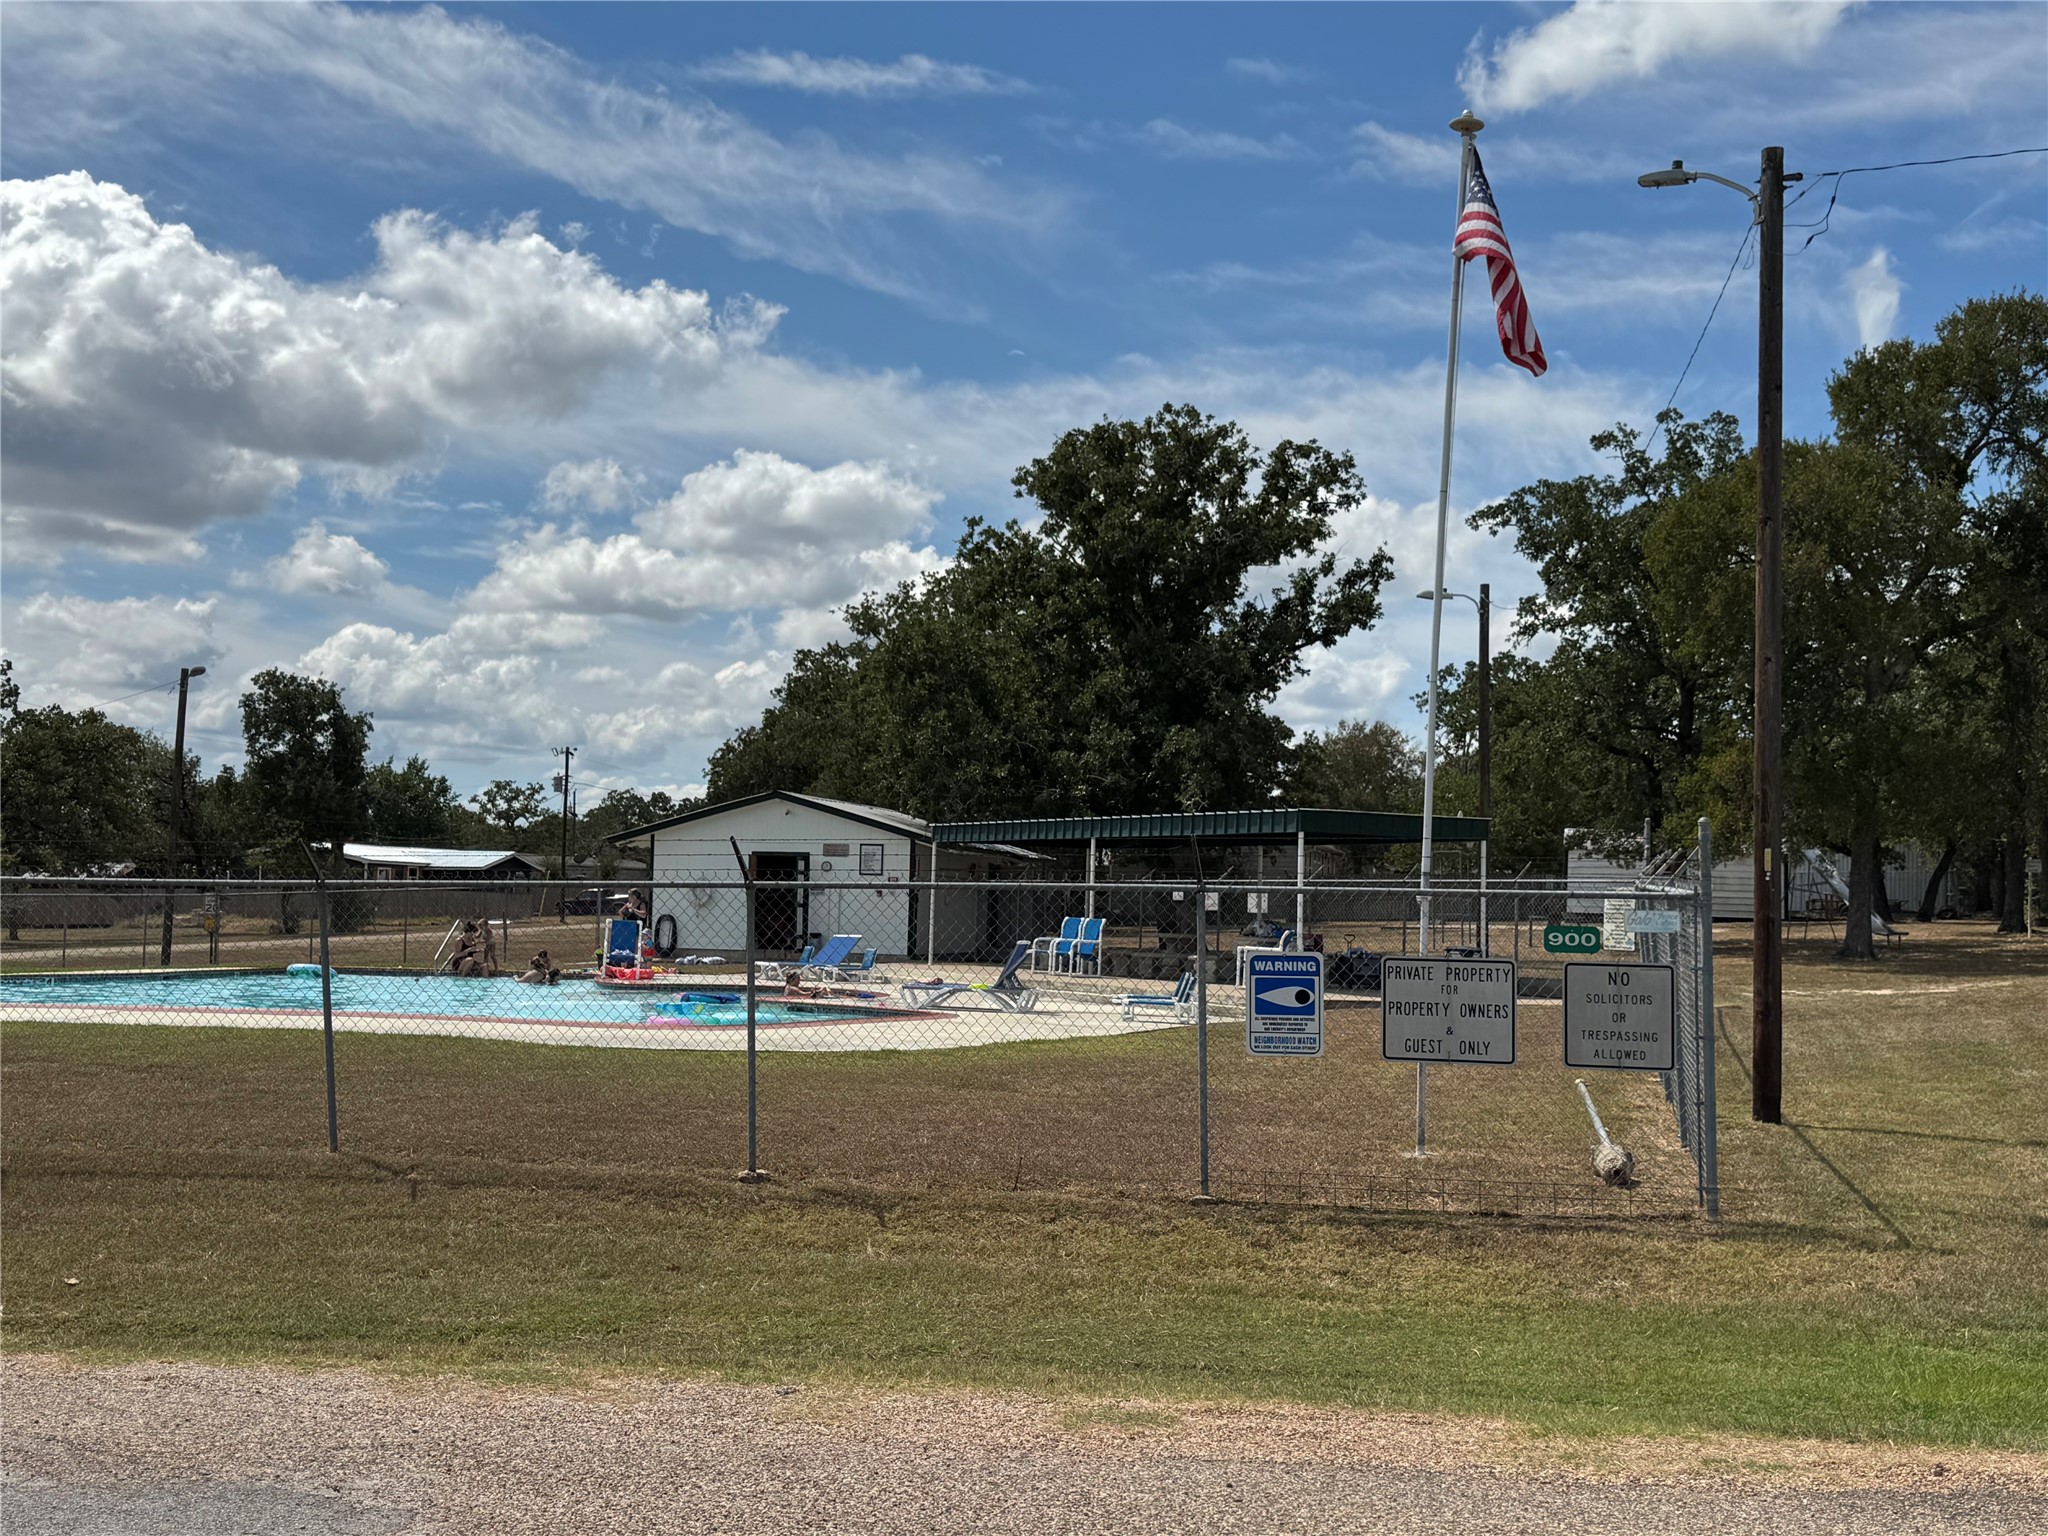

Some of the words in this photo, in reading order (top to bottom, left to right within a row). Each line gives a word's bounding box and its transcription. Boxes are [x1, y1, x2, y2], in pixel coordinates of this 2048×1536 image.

[1548, 932, 1596, 947] 900
[1254, 961, 1317, 972] WARNING
[1387, 965, 1434, 981] PRIVATE
[1446, 967, 1510, 983] PROPERTY
[1608, 971, 1630, 987] NO
[1441, 984, 1458, 995] FOR
[1586, 993, 1653, 1005] SOLICITORS
[1388, 1001, 1450, 1017] PROPERTY
[1460, 1003, 1509, 1019] OWNERS
[1612, 1012, 1626, 1023] OR
[1446, 1026, 1453, 1035] &
[1581, 1030, 1659, 1043] TRESPASSING
[1254, 1036, 1296, 1045] NEIGHBORHOOD
[1297, 1037, 1317, 1045] WATCH
[1404, 1038, 1442, 1054] GUEST
[1460, 1040, 1491, 1055] ONLY
[1593, 1049, 1646, 1061] ALLOWED
